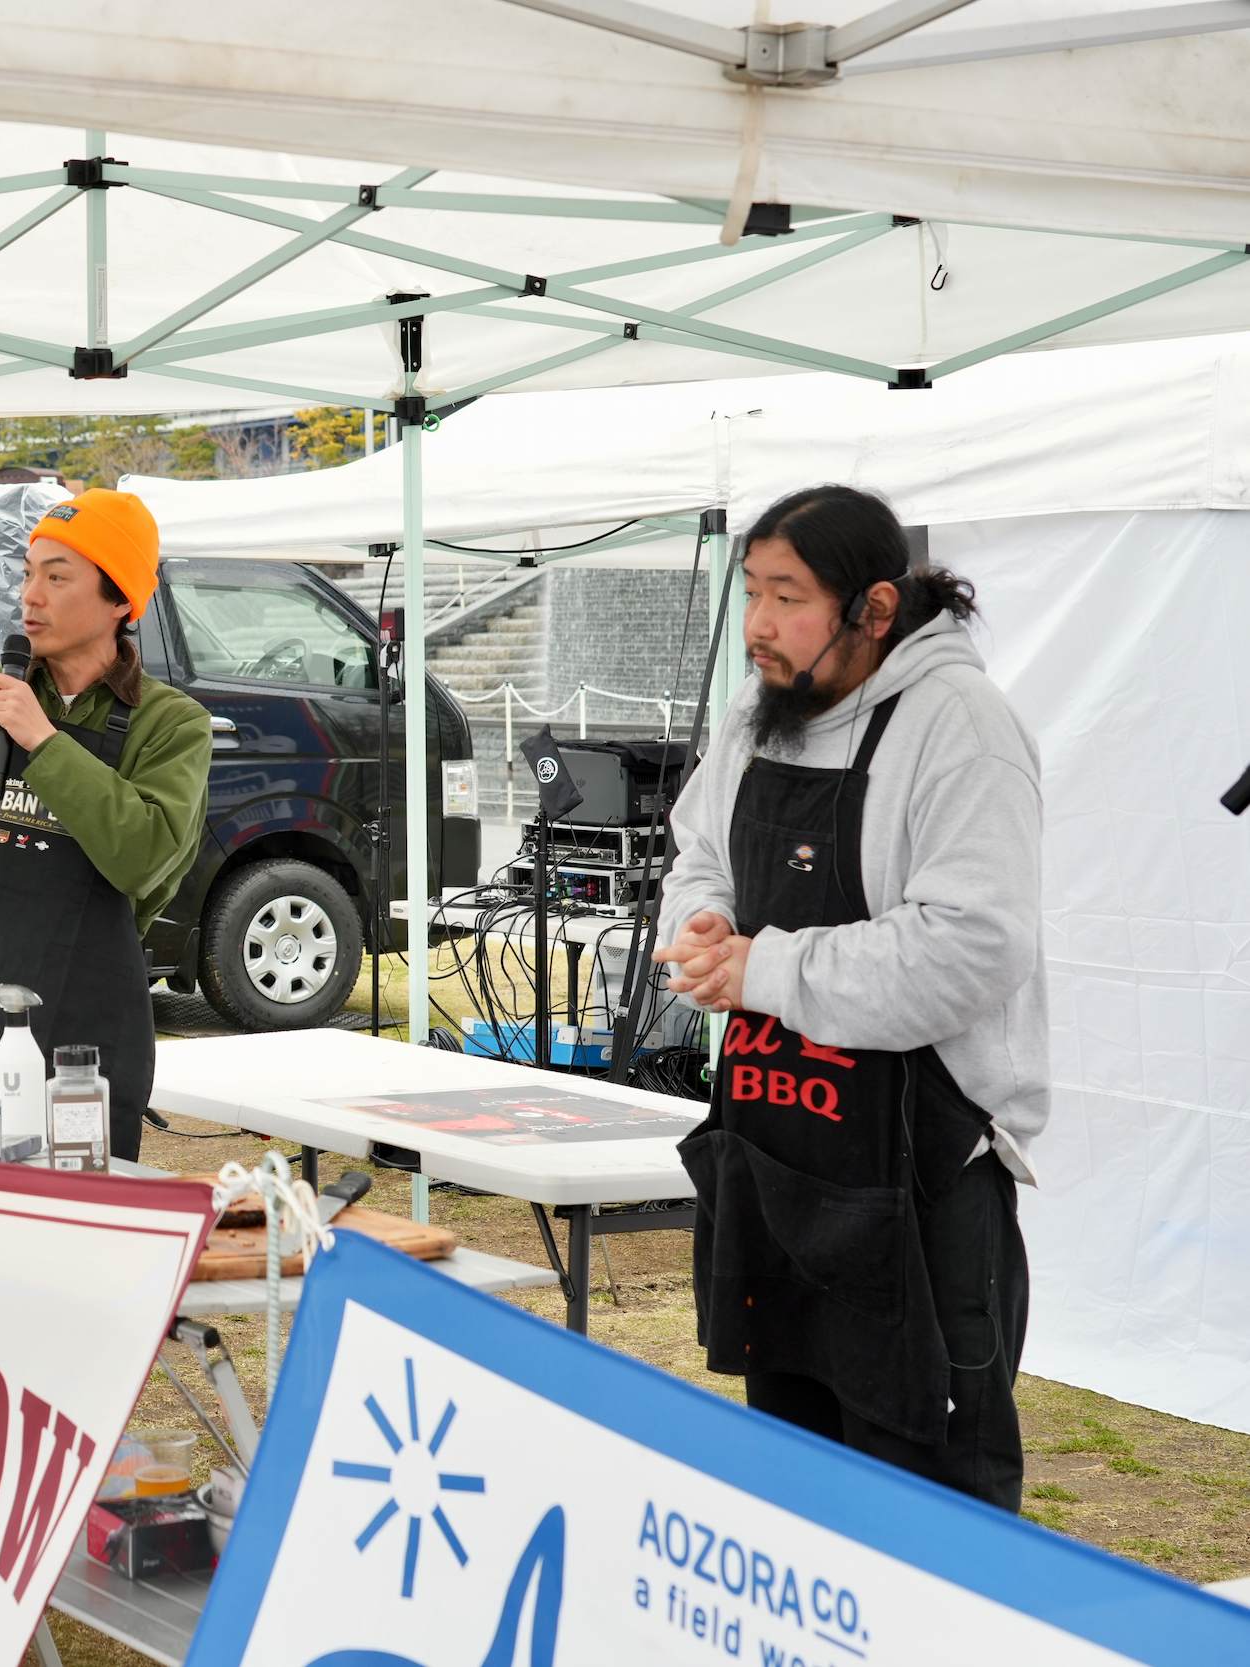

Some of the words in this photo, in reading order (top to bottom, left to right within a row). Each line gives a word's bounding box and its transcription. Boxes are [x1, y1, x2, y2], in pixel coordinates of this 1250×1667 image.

[732, 1064, 843, 1122] BBQ
[639, 1500, 804, 1629] AOZORA
[812, 1578, 869, 1643] CO.
[635, 1577, 650, 1610] a
[668, 1584, 741, 1657] field
